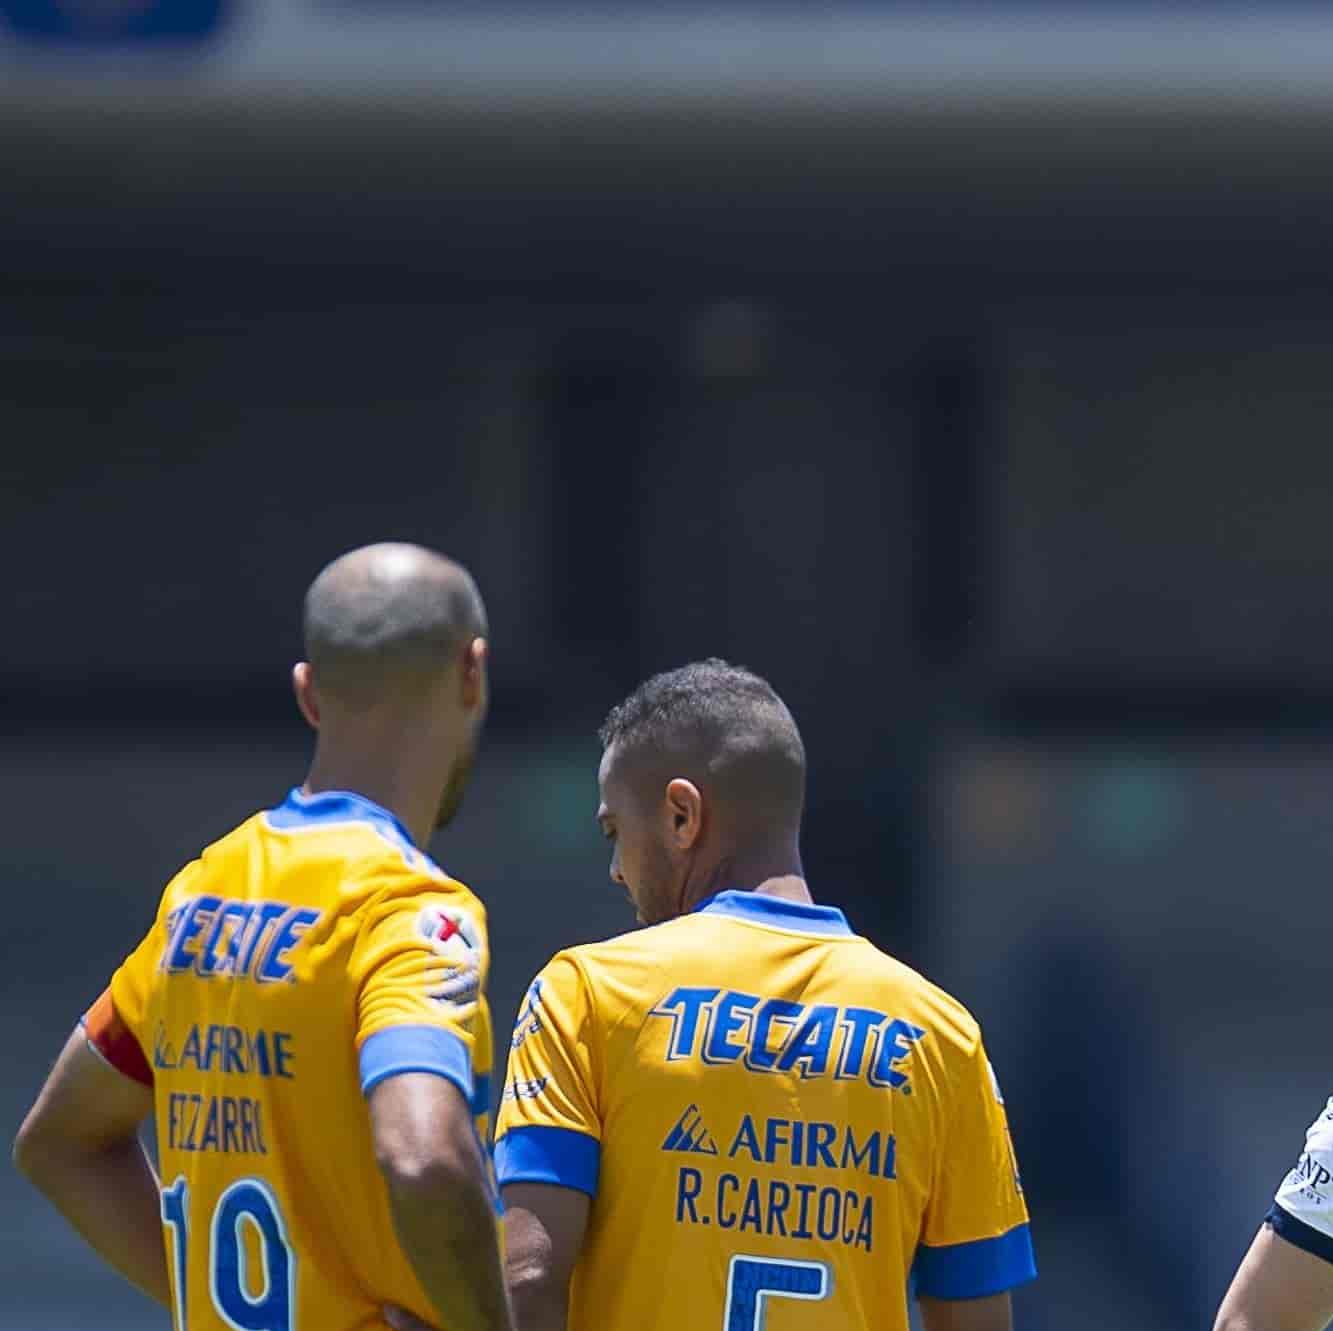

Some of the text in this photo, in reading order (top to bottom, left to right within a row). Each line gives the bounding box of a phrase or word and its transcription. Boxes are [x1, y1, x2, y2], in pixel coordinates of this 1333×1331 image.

[178, 1022, 297, 1079] AFRME
[648, 986, 927, 1090] TECATE
[675, 1167, 874, 1253] R.CARIOCA
